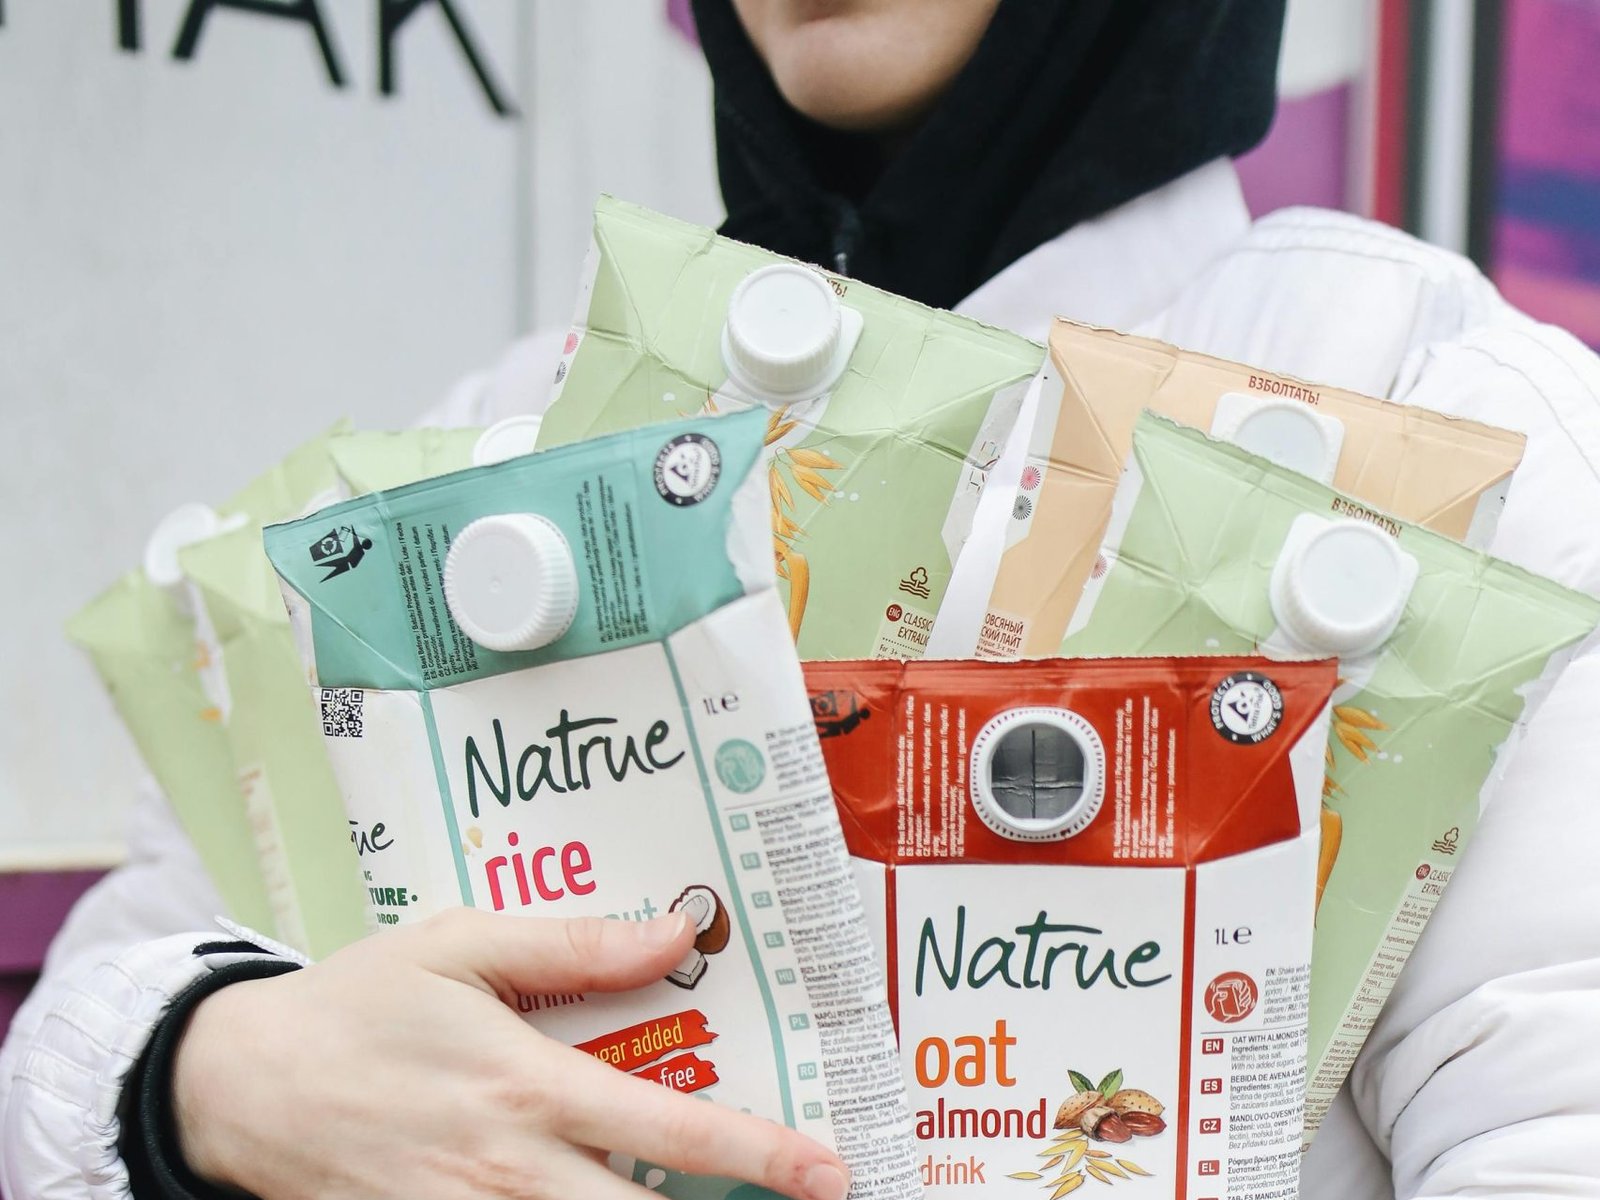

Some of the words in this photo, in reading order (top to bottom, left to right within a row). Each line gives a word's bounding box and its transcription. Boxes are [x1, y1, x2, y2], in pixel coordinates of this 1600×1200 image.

[1249, 376, 1320, 405] ВЗБОЛТАТЬ!
[1331, 498, 1402, 538] ВЗБОЛТАТЬ!
[402, 576, 414, 608] Production
[888, 608, 900, 619] ENG
[903, 613, 932, 631] CLASSIC
[985, 613, 1023, 635] ОВСЯНЫЙ
[981, 626, 999, 638] СКИЙ
[1000, 633, 1021, 648] ЛАЙТ
[1211, 676, 1234, 730] PROTECTS
[1263, 680, 1282, 710] GOOD
[1251, 710, 1281, 742] WHAT'S
[464, 708, 686, 817] Natrue
[485, 831, 597, 912] rice
[369, 888, 408, 906] TURE
[1215, 928, 1228, 945] 1L
[916, 906, 1172, 997] Natrue
[780, 972, 792, 980] HU
[791, 1017, 806, 1026] PL
[632, 1017, 683, 1057] added
[1206, 1042, 1220, 1051] EN
[1267, 1031, 1298, 1042] ALMONDS
[1232, 1043, 1270, 1053] Ingredients:
[915, 1019, 1017, 1089] oat
[1256, 1060, 1275, 1069] added
[660, 1067, 696, 1089] free
[800, 1067, 815, 1076] RO
[1204, 1081, 1218, 1091] ES
[1231, 1075, 1256, 1083] BEBIDA
[1269, 1071, 1290, 1079] AVENA
[1230, 1083, 1272, 1093] Ingredientes:
[804, 1106, 820, 1115] RU
[916, 1098, 1047, 1140] almond
[1203, 1121, 1217, 1130] CZ
[921, 1155, 986, 1186] drink
[1202, 1163, 1215, 1172] EL
[850, 1179, 873, 1191] YŽOVÝ
